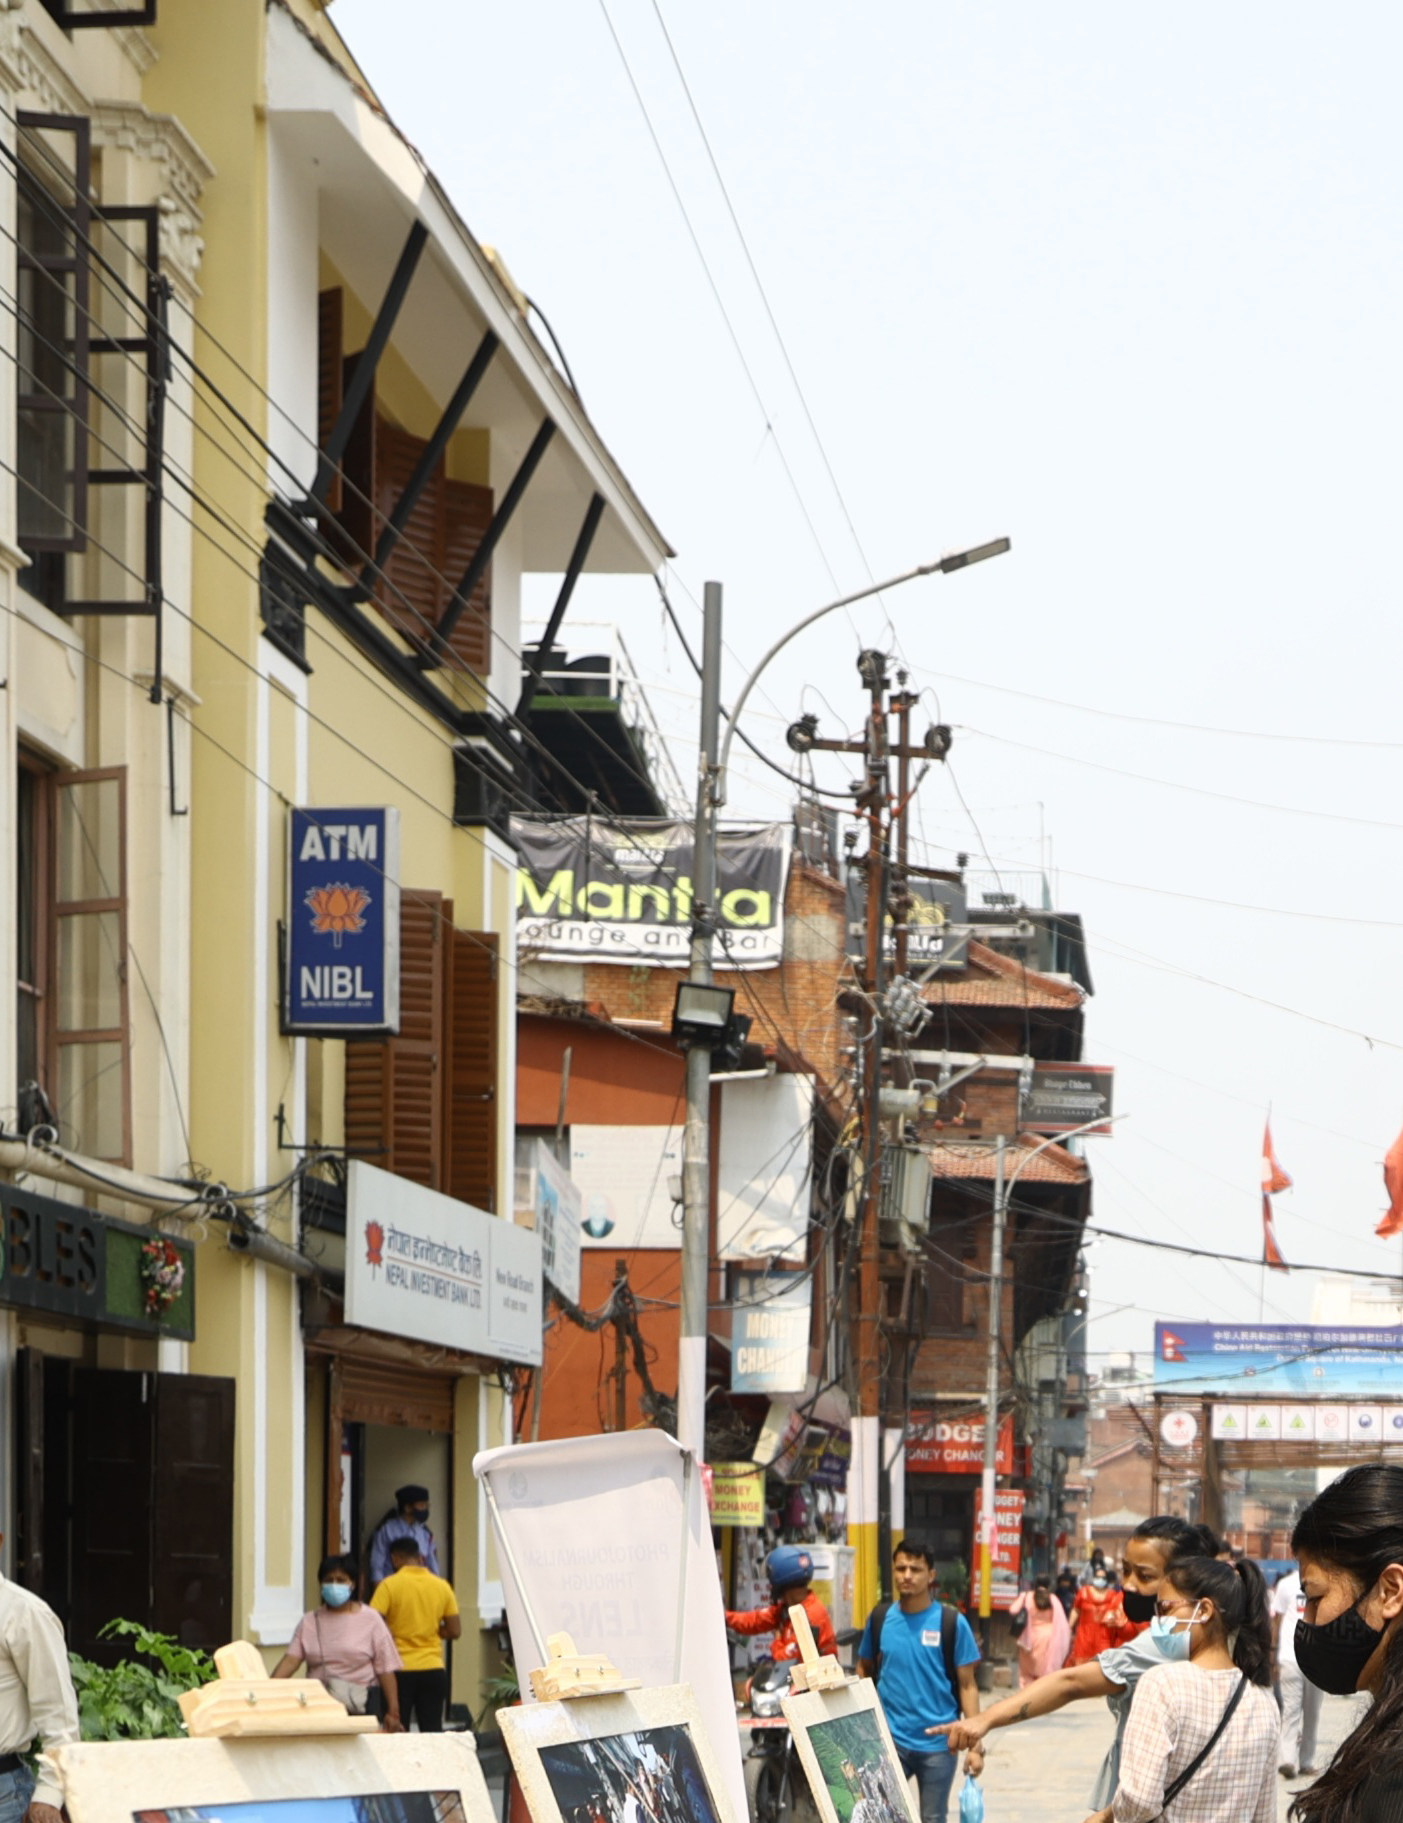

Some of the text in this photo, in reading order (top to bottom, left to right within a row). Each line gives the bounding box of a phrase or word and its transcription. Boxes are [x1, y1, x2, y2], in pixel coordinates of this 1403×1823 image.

[299, 824, 378, 863] ATM
[515, 867, 772, 928] Manta
[525, 921, 626, 947] ounge
[300, 965, 375, 1000] NIBL
[385, 1261, 408, 1291] NEPAL
[410, 1270, 451, 1302] INVESTMENT
[451, 1282, 469, 1306] BANK
[907, 1422, 1002, 1443] BUDGE
[907, 1448, 941, 1461] ONEY
[715, 1484, 751, 1497] MONEY
